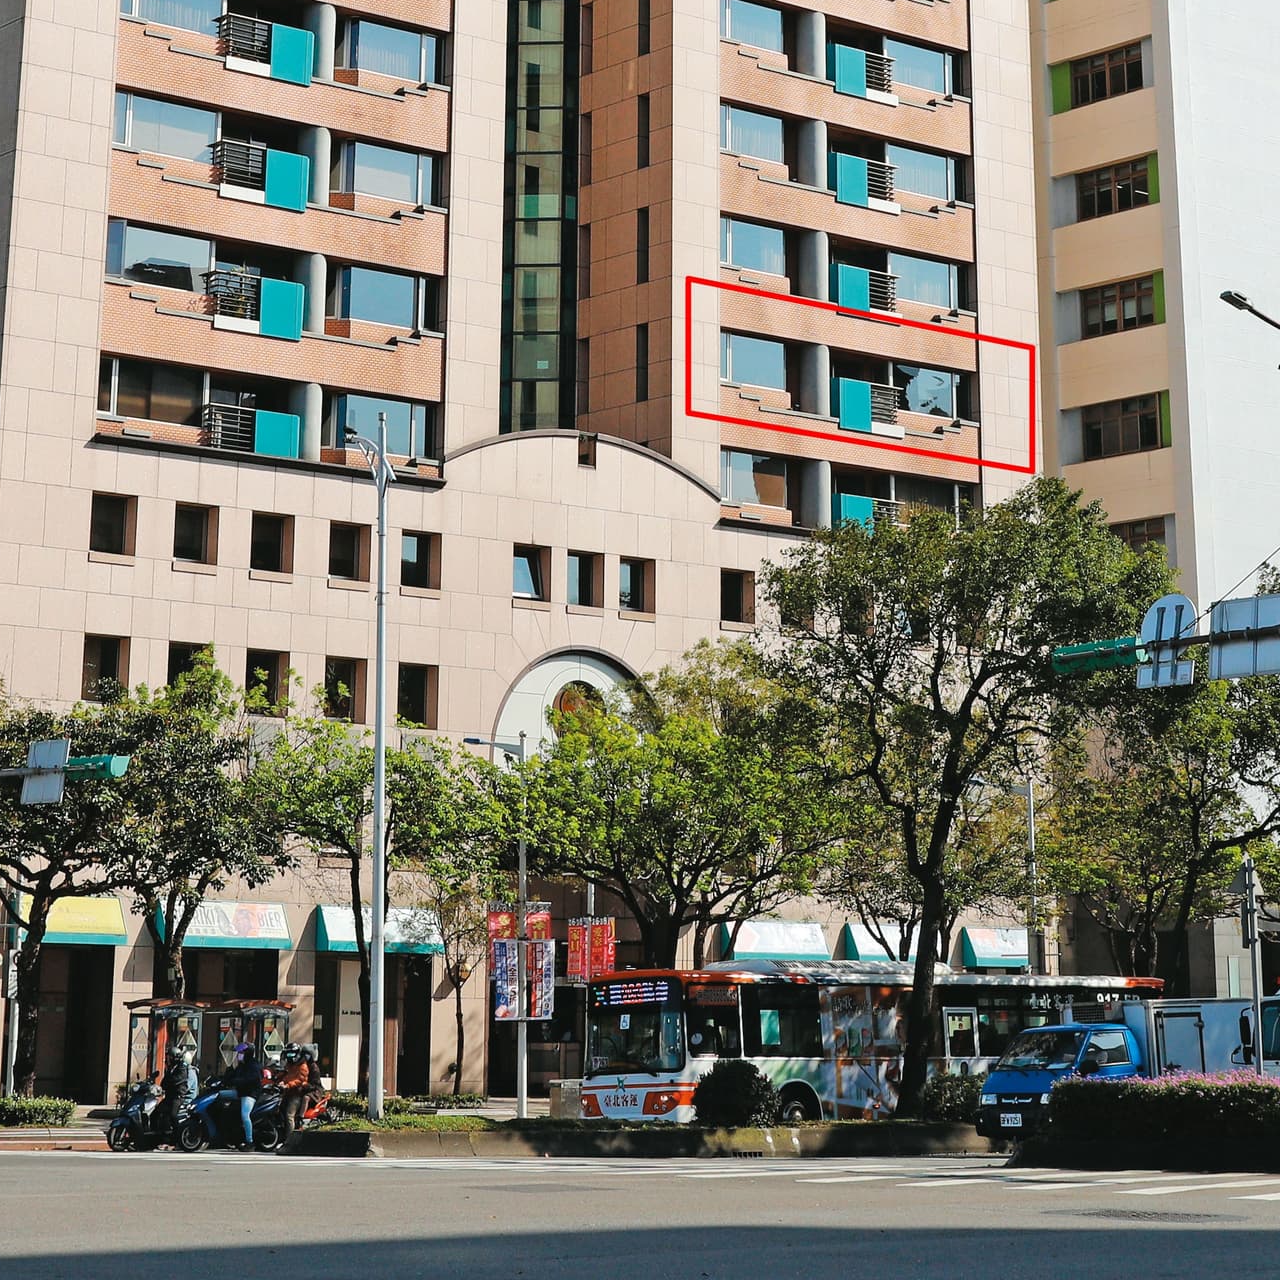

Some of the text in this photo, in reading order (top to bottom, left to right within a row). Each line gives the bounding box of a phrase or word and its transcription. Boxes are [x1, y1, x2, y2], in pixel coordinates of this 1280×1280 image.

[257, 911, 283, 929] BIER
[603, 1093, 639, 1108] 臺北客運
